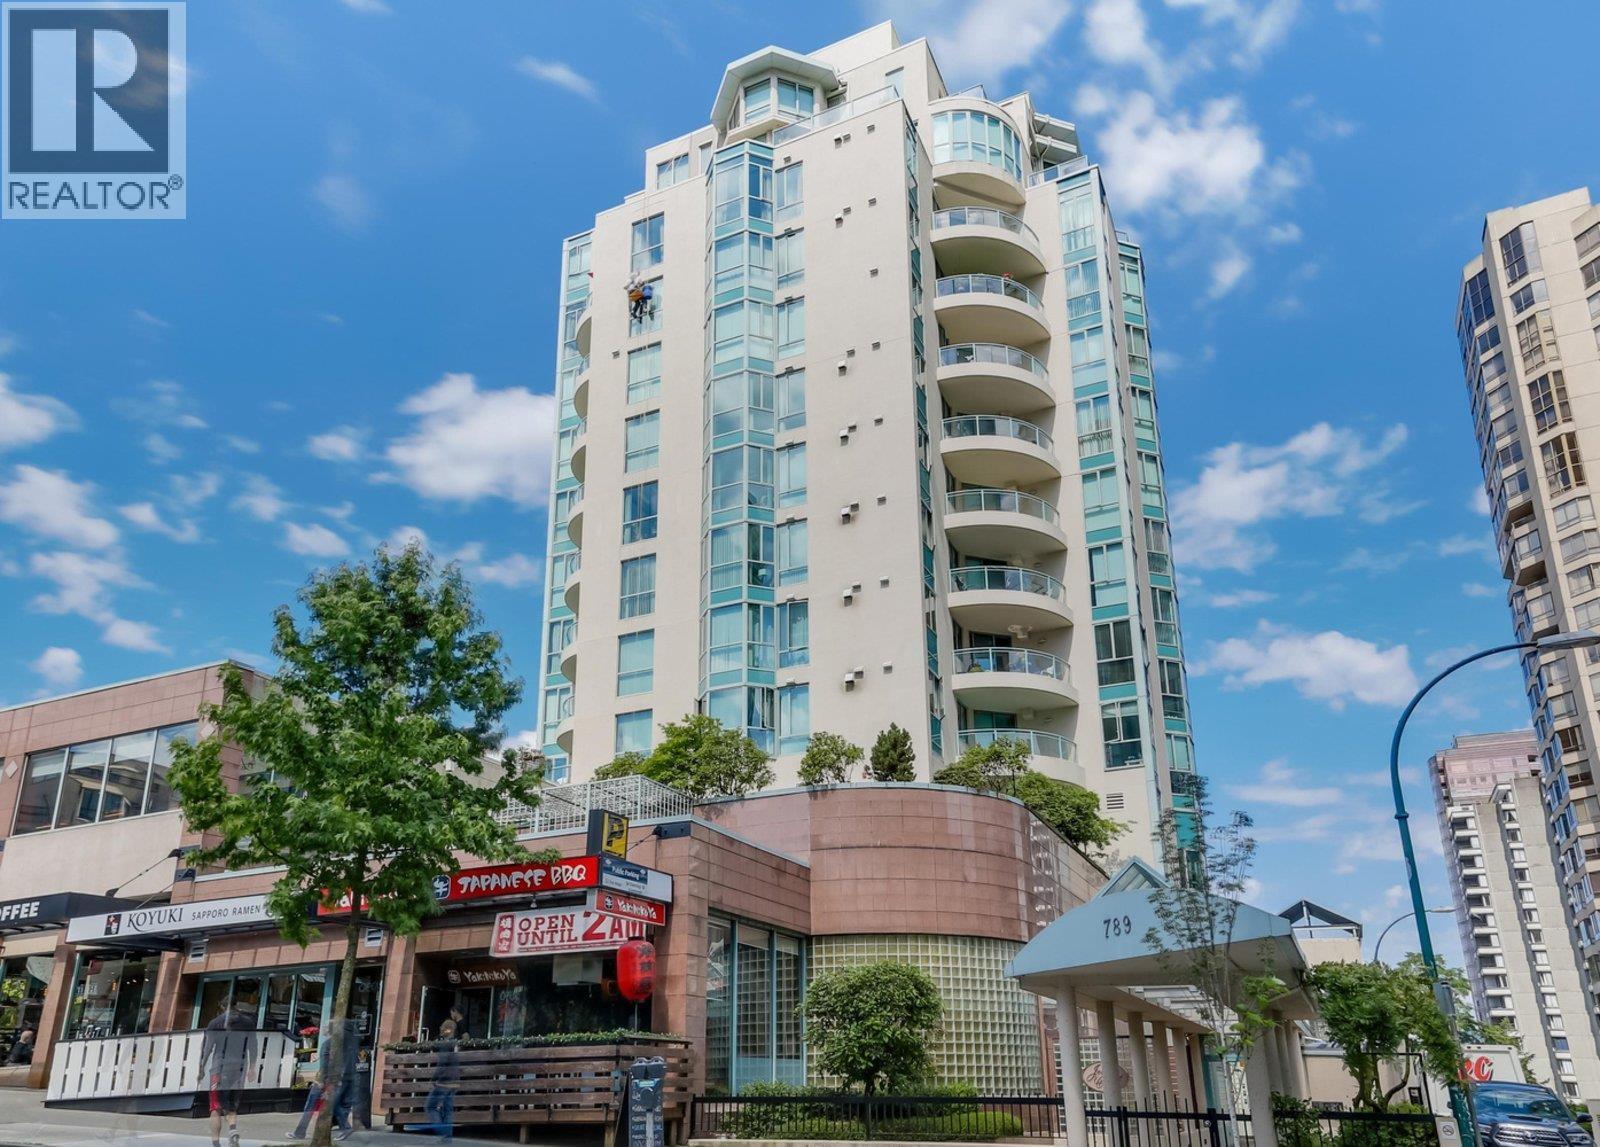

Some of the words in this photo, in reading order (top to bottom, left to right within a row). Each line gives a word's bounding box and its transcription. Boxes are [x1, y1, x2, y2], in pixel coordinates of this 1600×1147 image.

[458, 869, 546, 894] JAPANESE
[551, 864, 586, 885] BBQ
[0, 901, 40, 921] FFEE
[127, 907, 183, 932] KOYUKI
[191, 908, 228, 921] SAPPORO
[232, 904, 261, 916] RAMEN
[518, 914, 575, 932] OPEN
[1103, 915, 1132, 939] 789
[517, 929, 577, 946] UNTIL
